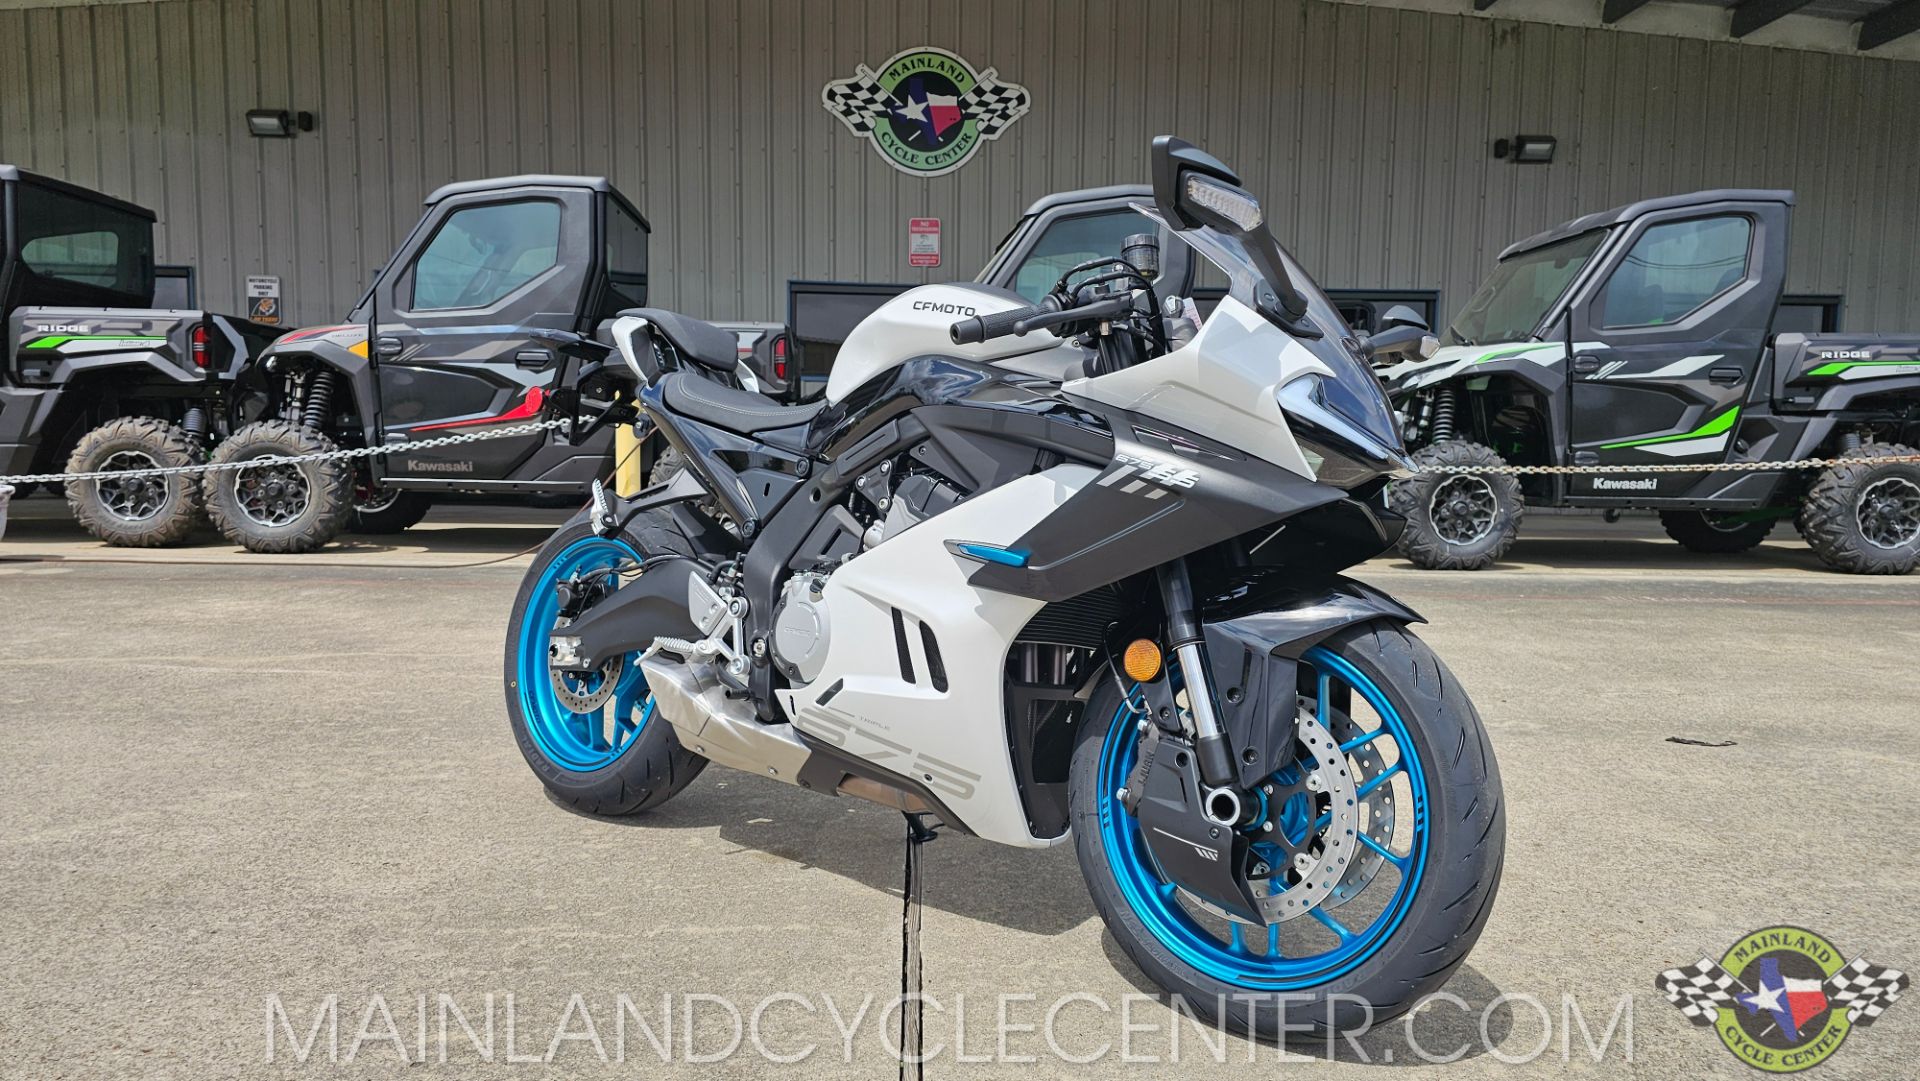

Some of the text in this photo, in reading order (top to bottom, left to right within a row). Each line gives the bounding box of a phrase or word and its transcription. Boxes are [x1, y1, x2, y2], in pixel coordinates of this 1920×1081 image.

[888, 56, 966, 84] MAINLAND
[881, 130, 973, 166] CYCLE CENTER
[912, 300, 976, 317] CFMOTO
[37, 324, 89, 333] RIDGE
[1821, 350, 1870, 359] RIDGE
[407, 459, 473, 472] Kawasaki
[1592, 477, 1658, 490] Kawasaki
